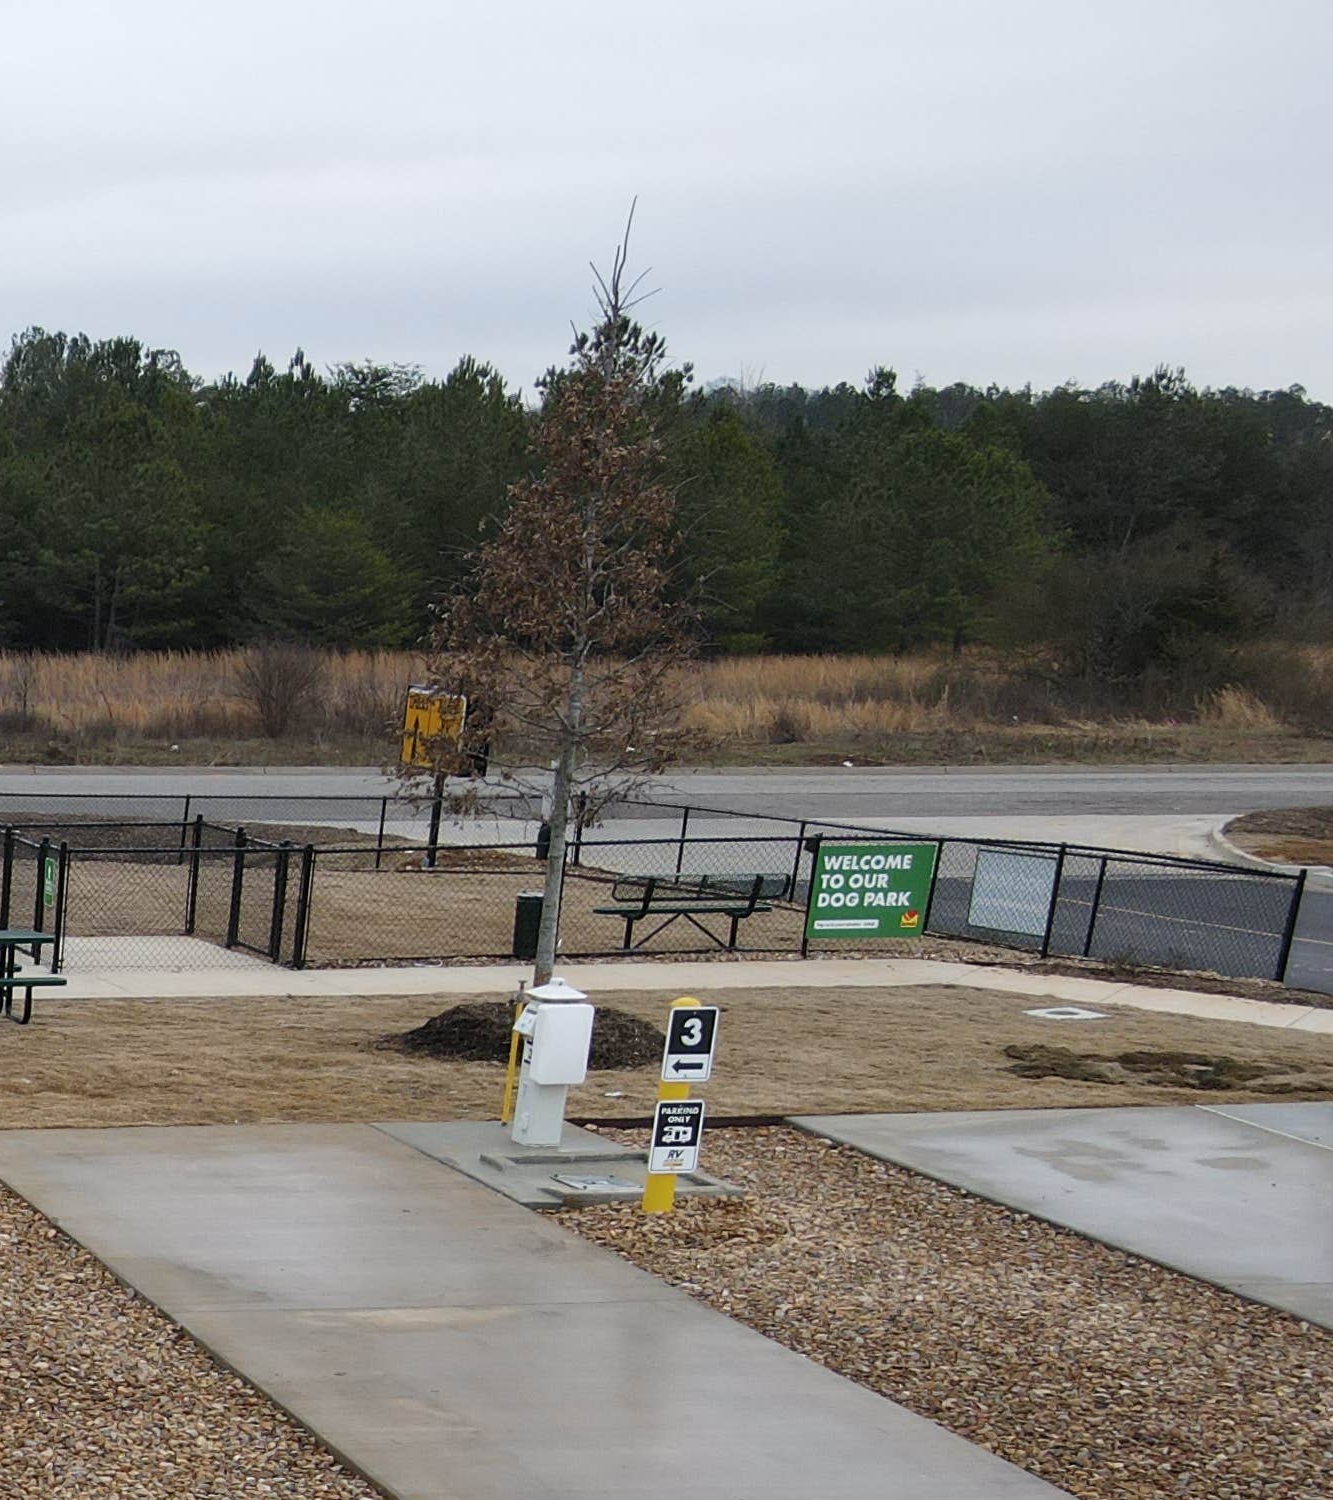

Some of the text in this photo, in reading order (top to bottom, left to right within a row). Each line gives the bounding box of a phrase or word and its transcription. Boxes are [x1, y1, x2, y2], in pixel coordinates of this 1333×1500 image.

[823, 854, 913, 870] WELCOME
[820, 873, 889, 889] TO OUR
[817, 891, 912, 908] DOG PARK
[680, 1018, 703, 1046] 3
[661, 1106, 699, 1115] PARKING
[667, 1115, 691, 1124] ONLY
[667, 1150, 684, 1159] RV
